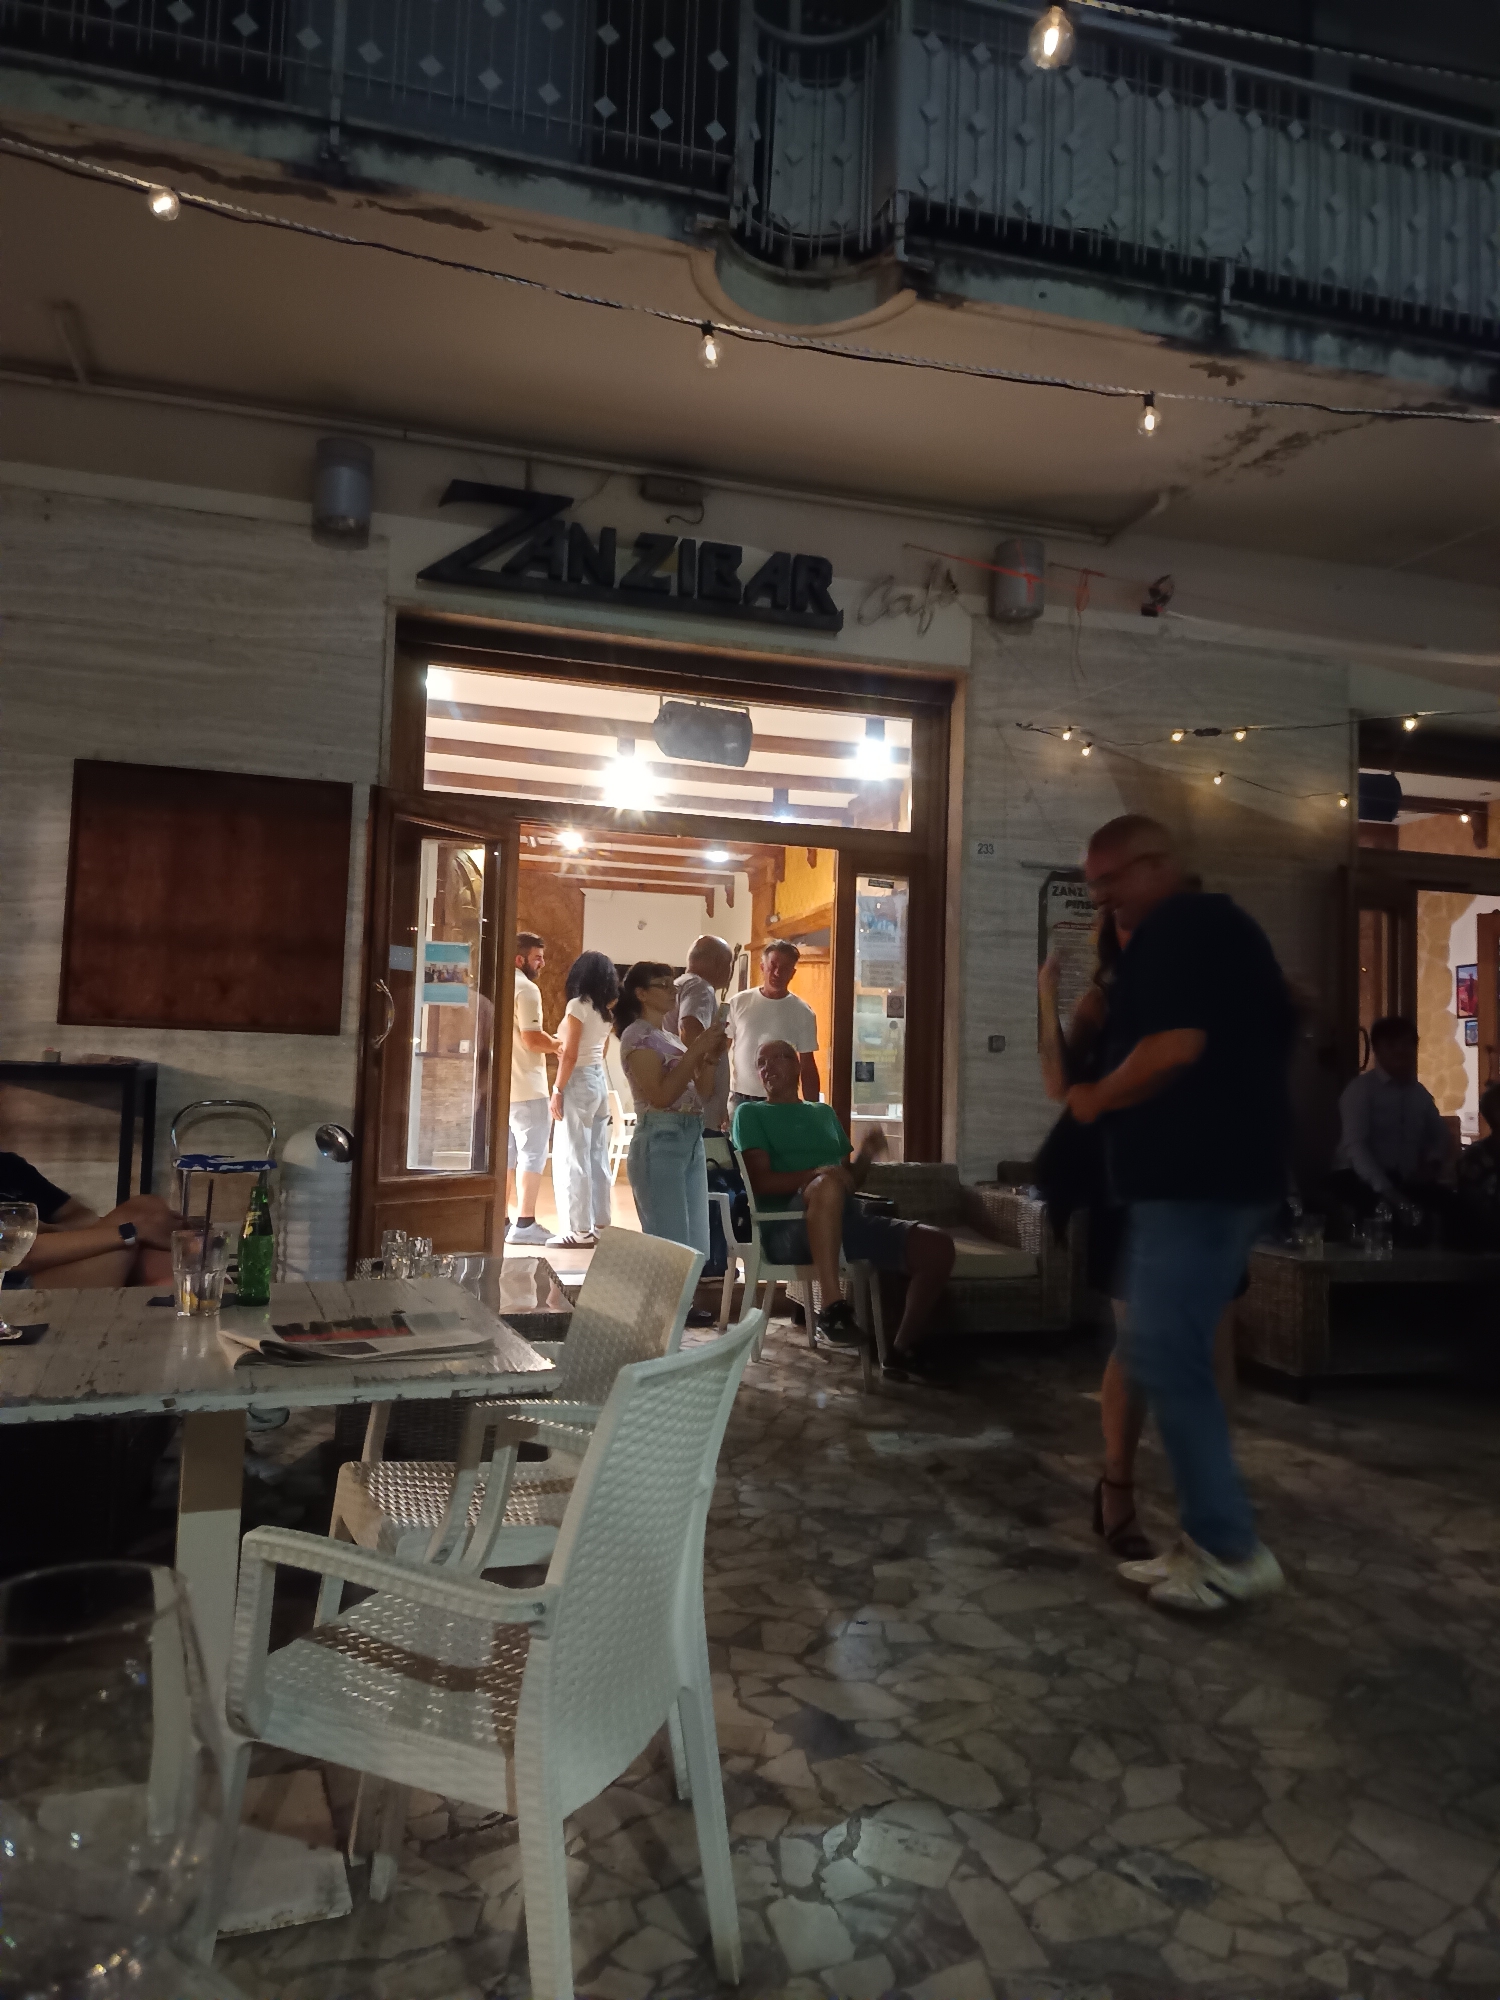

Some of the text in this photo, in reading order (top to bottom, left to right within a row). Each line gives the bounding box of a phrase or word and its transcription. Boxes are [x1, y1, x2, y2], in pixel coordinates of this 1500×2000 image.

[416, 479, 843, 632] ZANZIBAR
[977, 843, 994, 855] 233
[1052, 885, 1087, 897] ZANZ
